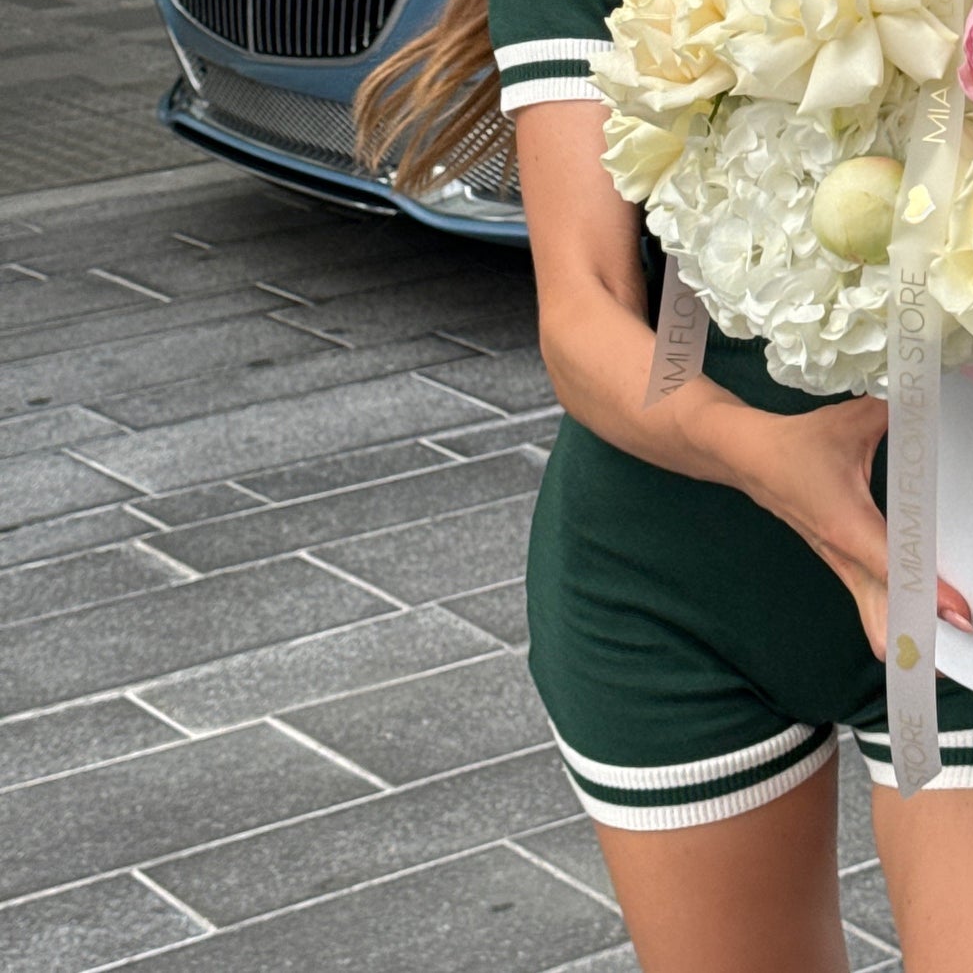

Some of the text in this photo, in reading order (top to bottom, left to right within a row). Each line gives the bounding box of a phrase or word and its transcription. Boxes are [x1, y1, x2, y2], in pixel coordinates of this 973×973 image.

[922, 87, 951, 144] MIA
[898, 267, 927, 594] MIAMI FLOWER STORE
